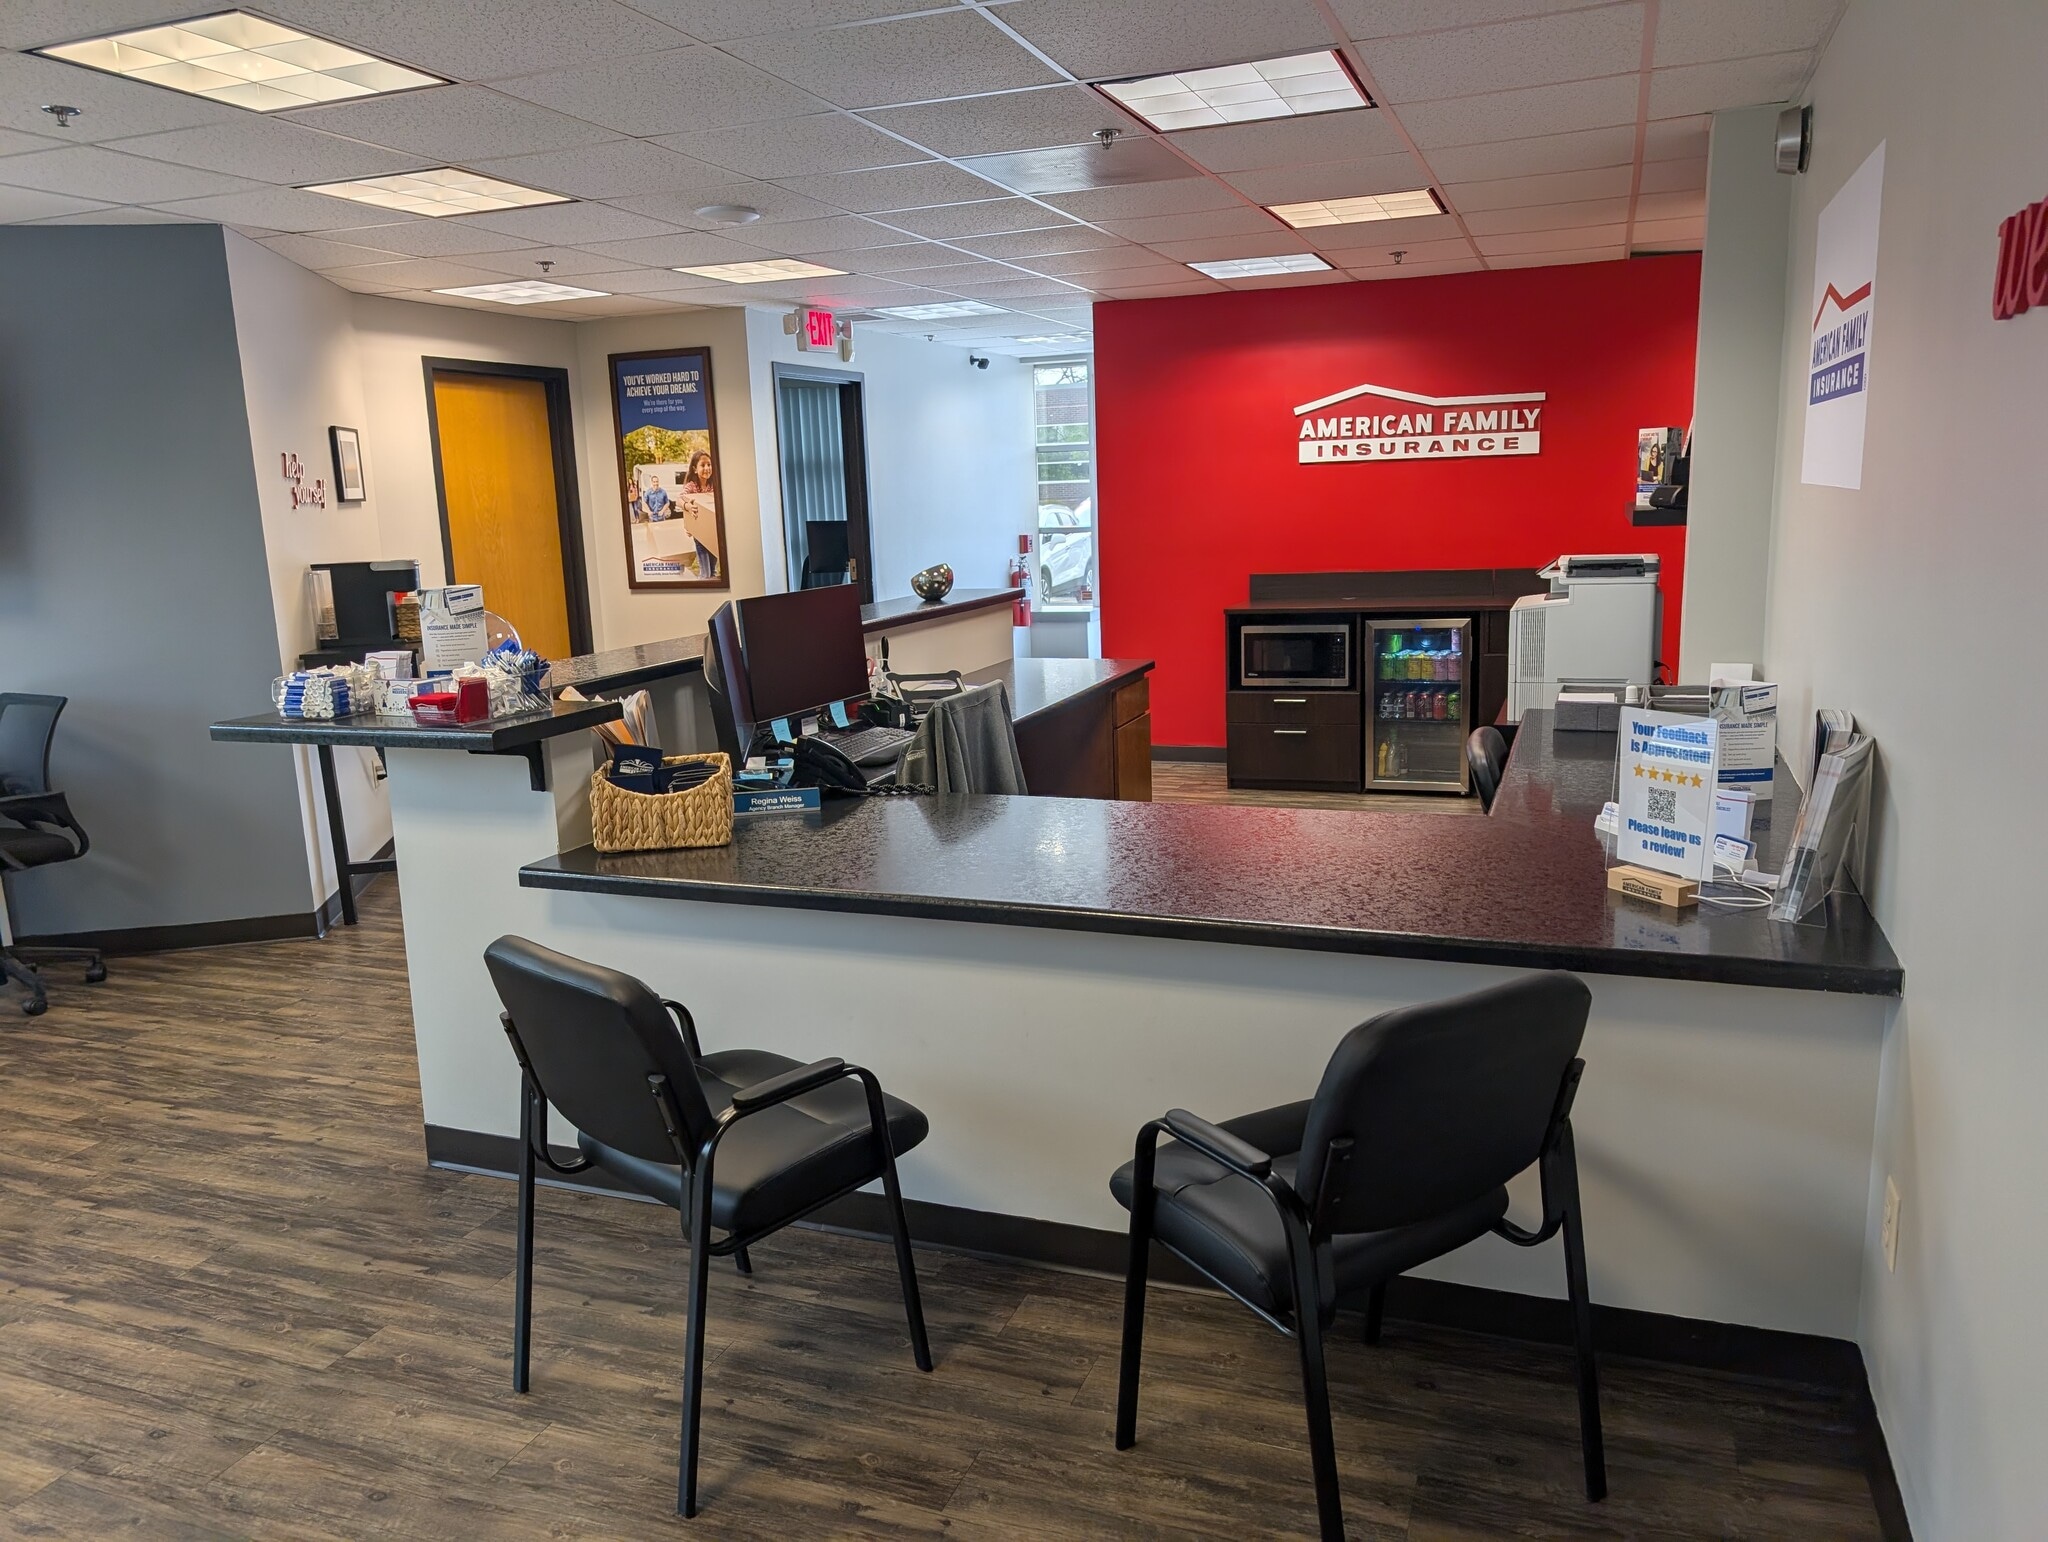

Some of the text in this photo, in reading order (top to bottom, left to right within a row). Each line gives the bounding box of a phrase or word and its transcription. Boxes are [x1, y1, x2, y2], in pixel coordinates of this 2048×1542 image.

[808, 311, 833, 346] EXIT
[1812, 310, 1868, 369] AMERICAN FAMILY
[623, 370, 699, 386] YOU'VE WORKED HARD TO
[627, 382, 698, 397] ACHIEVE YOUR DREAMS.
[1813, 362, 1860, 398] INSURANCE
[1300, 408, 1541, 439] AMERICAN FAMILY
[1317, 436, 1520, 458] INSURANCE
[282, 452, 305, 484] help
[292, 479, 327, 510] yourself
[1632, 721, 1655, 737] Your
[1657, 725, 1708, 745] Feedback
[1642, 741, 1710, 764] Appreciated!
[751, 795, 802, 806] Regina Weiss
[1628, 818, 1659, 836] Please
[1661, 826, 1687, 842] leave
[1688, 833, 1701, 846] us
[1642, 839, 1685, 859] a review!
